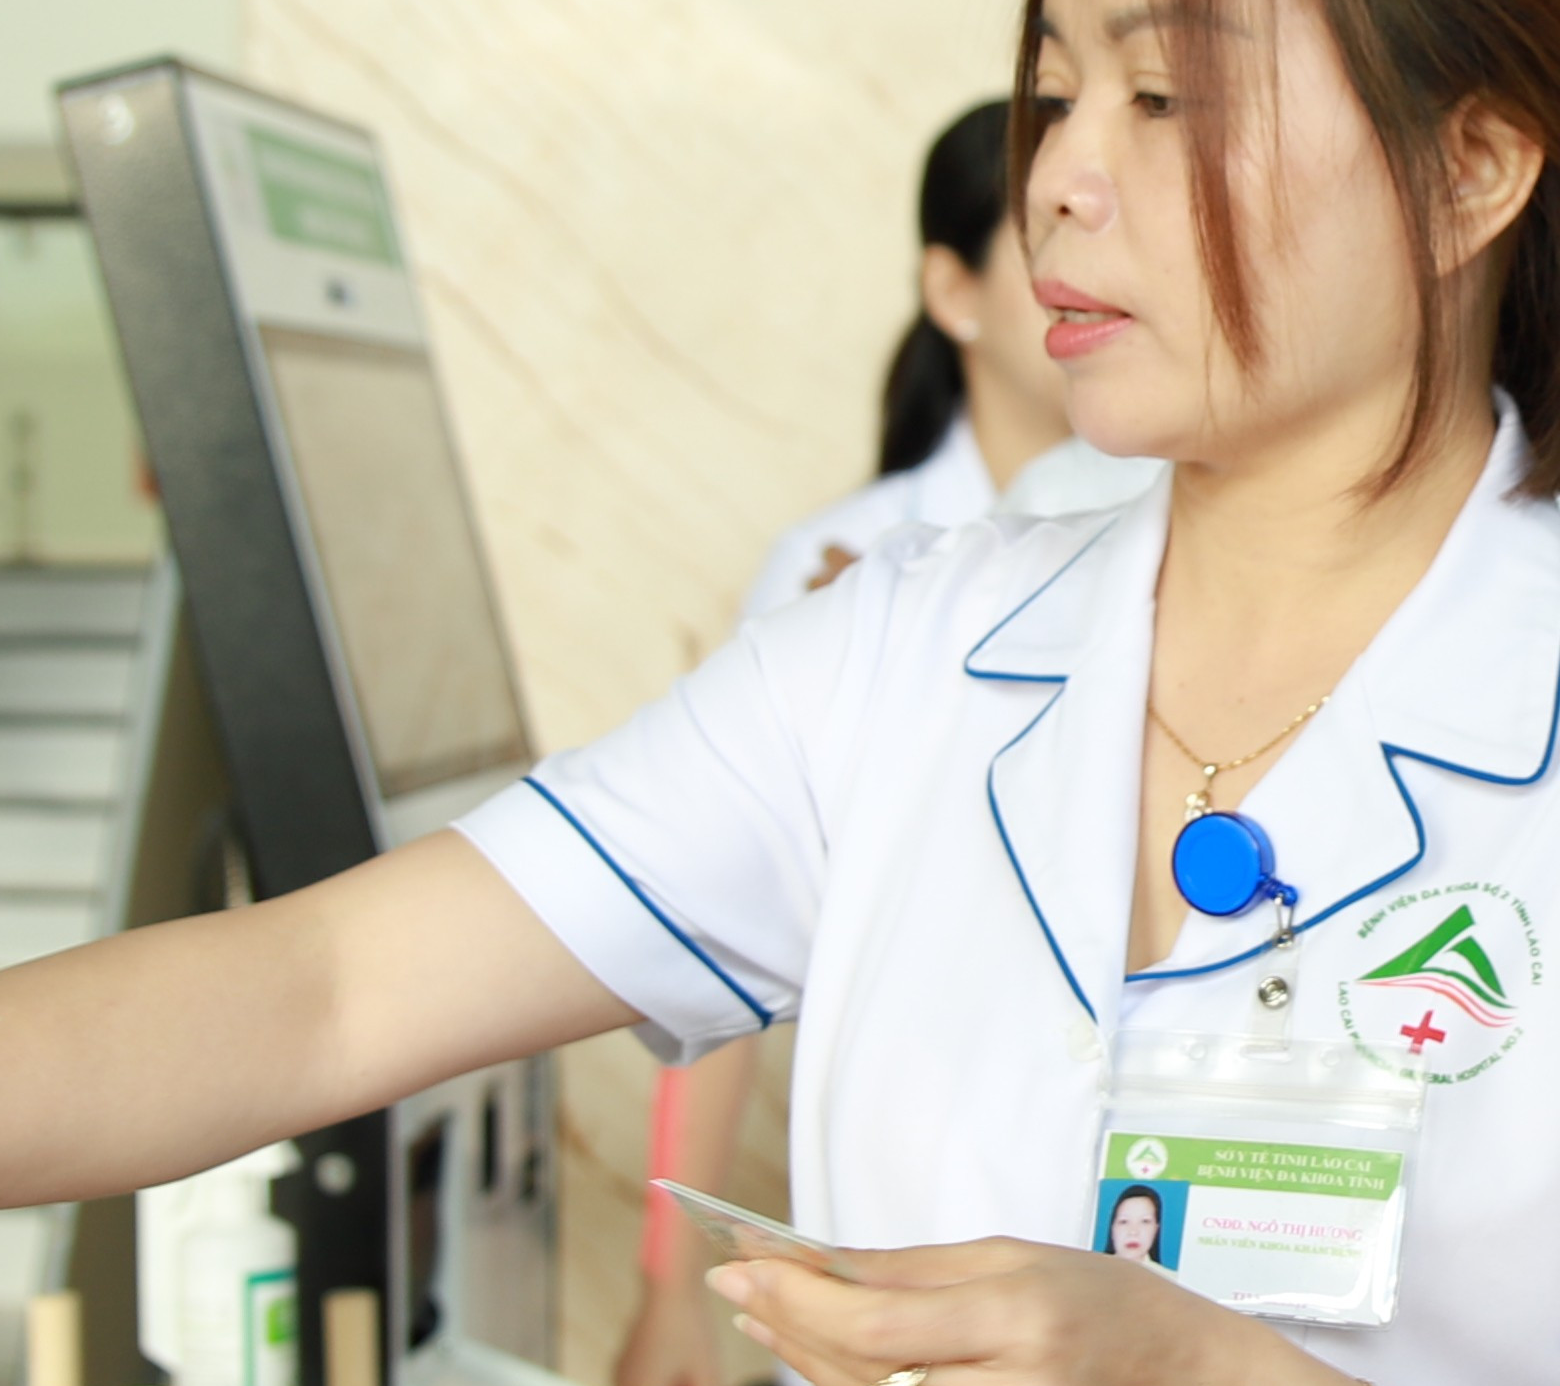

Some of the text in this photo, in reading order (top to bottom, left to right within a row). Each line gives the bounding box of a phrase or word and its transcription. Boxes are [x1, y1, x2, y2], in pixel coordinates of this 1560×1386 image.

[1531, 962, 1542, 986] CAI
[1235, 1151, 1246, 1162] Y
[1250, 1149, 1270, 1164] TẾ
[1344, 1158, 1372, 1173] CAI
[1197, 1164, 1386, 1191] BỆNH VIỆN ĐA KHOA TỈNH
[1247, 1218, 1279, 1234] NGÔ
[1282, 1222, 1307, 1238] THỊ
